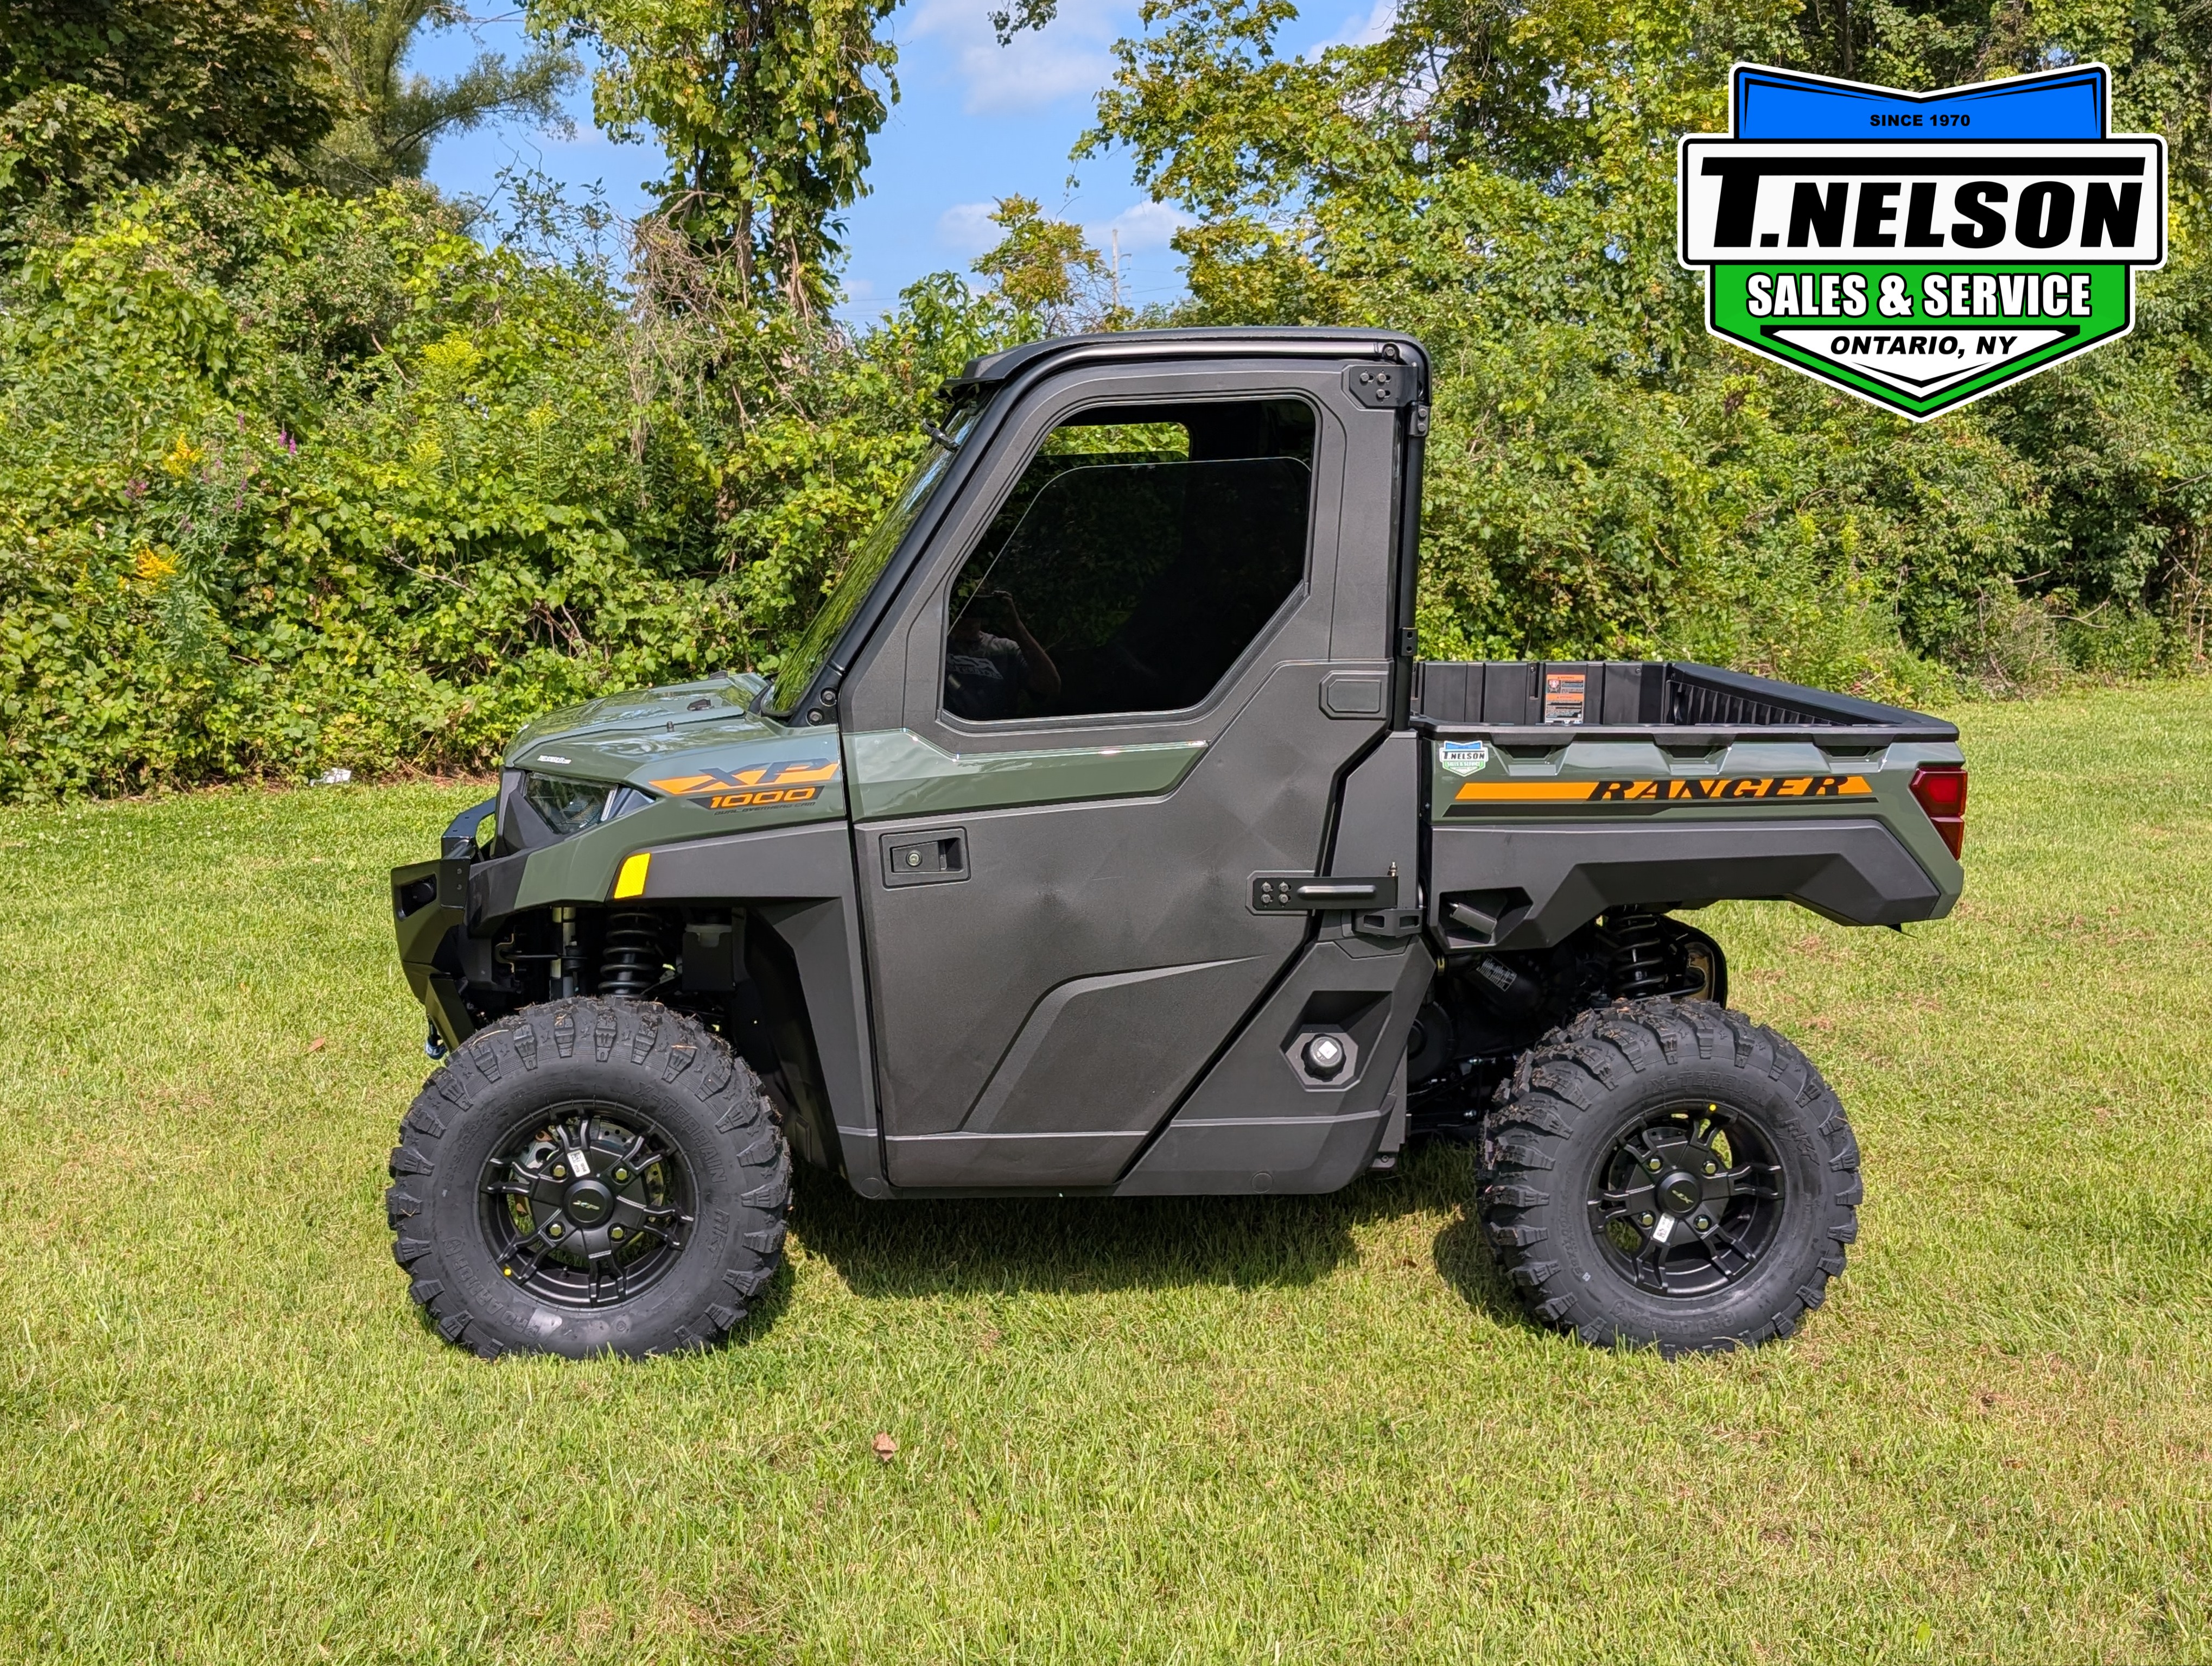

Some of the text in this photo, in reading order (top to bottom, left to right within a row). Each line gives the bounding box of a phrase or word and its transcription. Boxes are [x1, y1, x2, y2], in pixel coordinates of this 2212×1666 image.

[1442, 750, 1485, 759] T.NELSON
[680, 758, 831, 793] XP
[1586, 776, 1849, 801] RANGER
[710, 787, 816, 809] 1000
[633, 1081, 727, 1183] X-TERRAIN
[453, 1253, 541, 1339] PRO ARMOR
